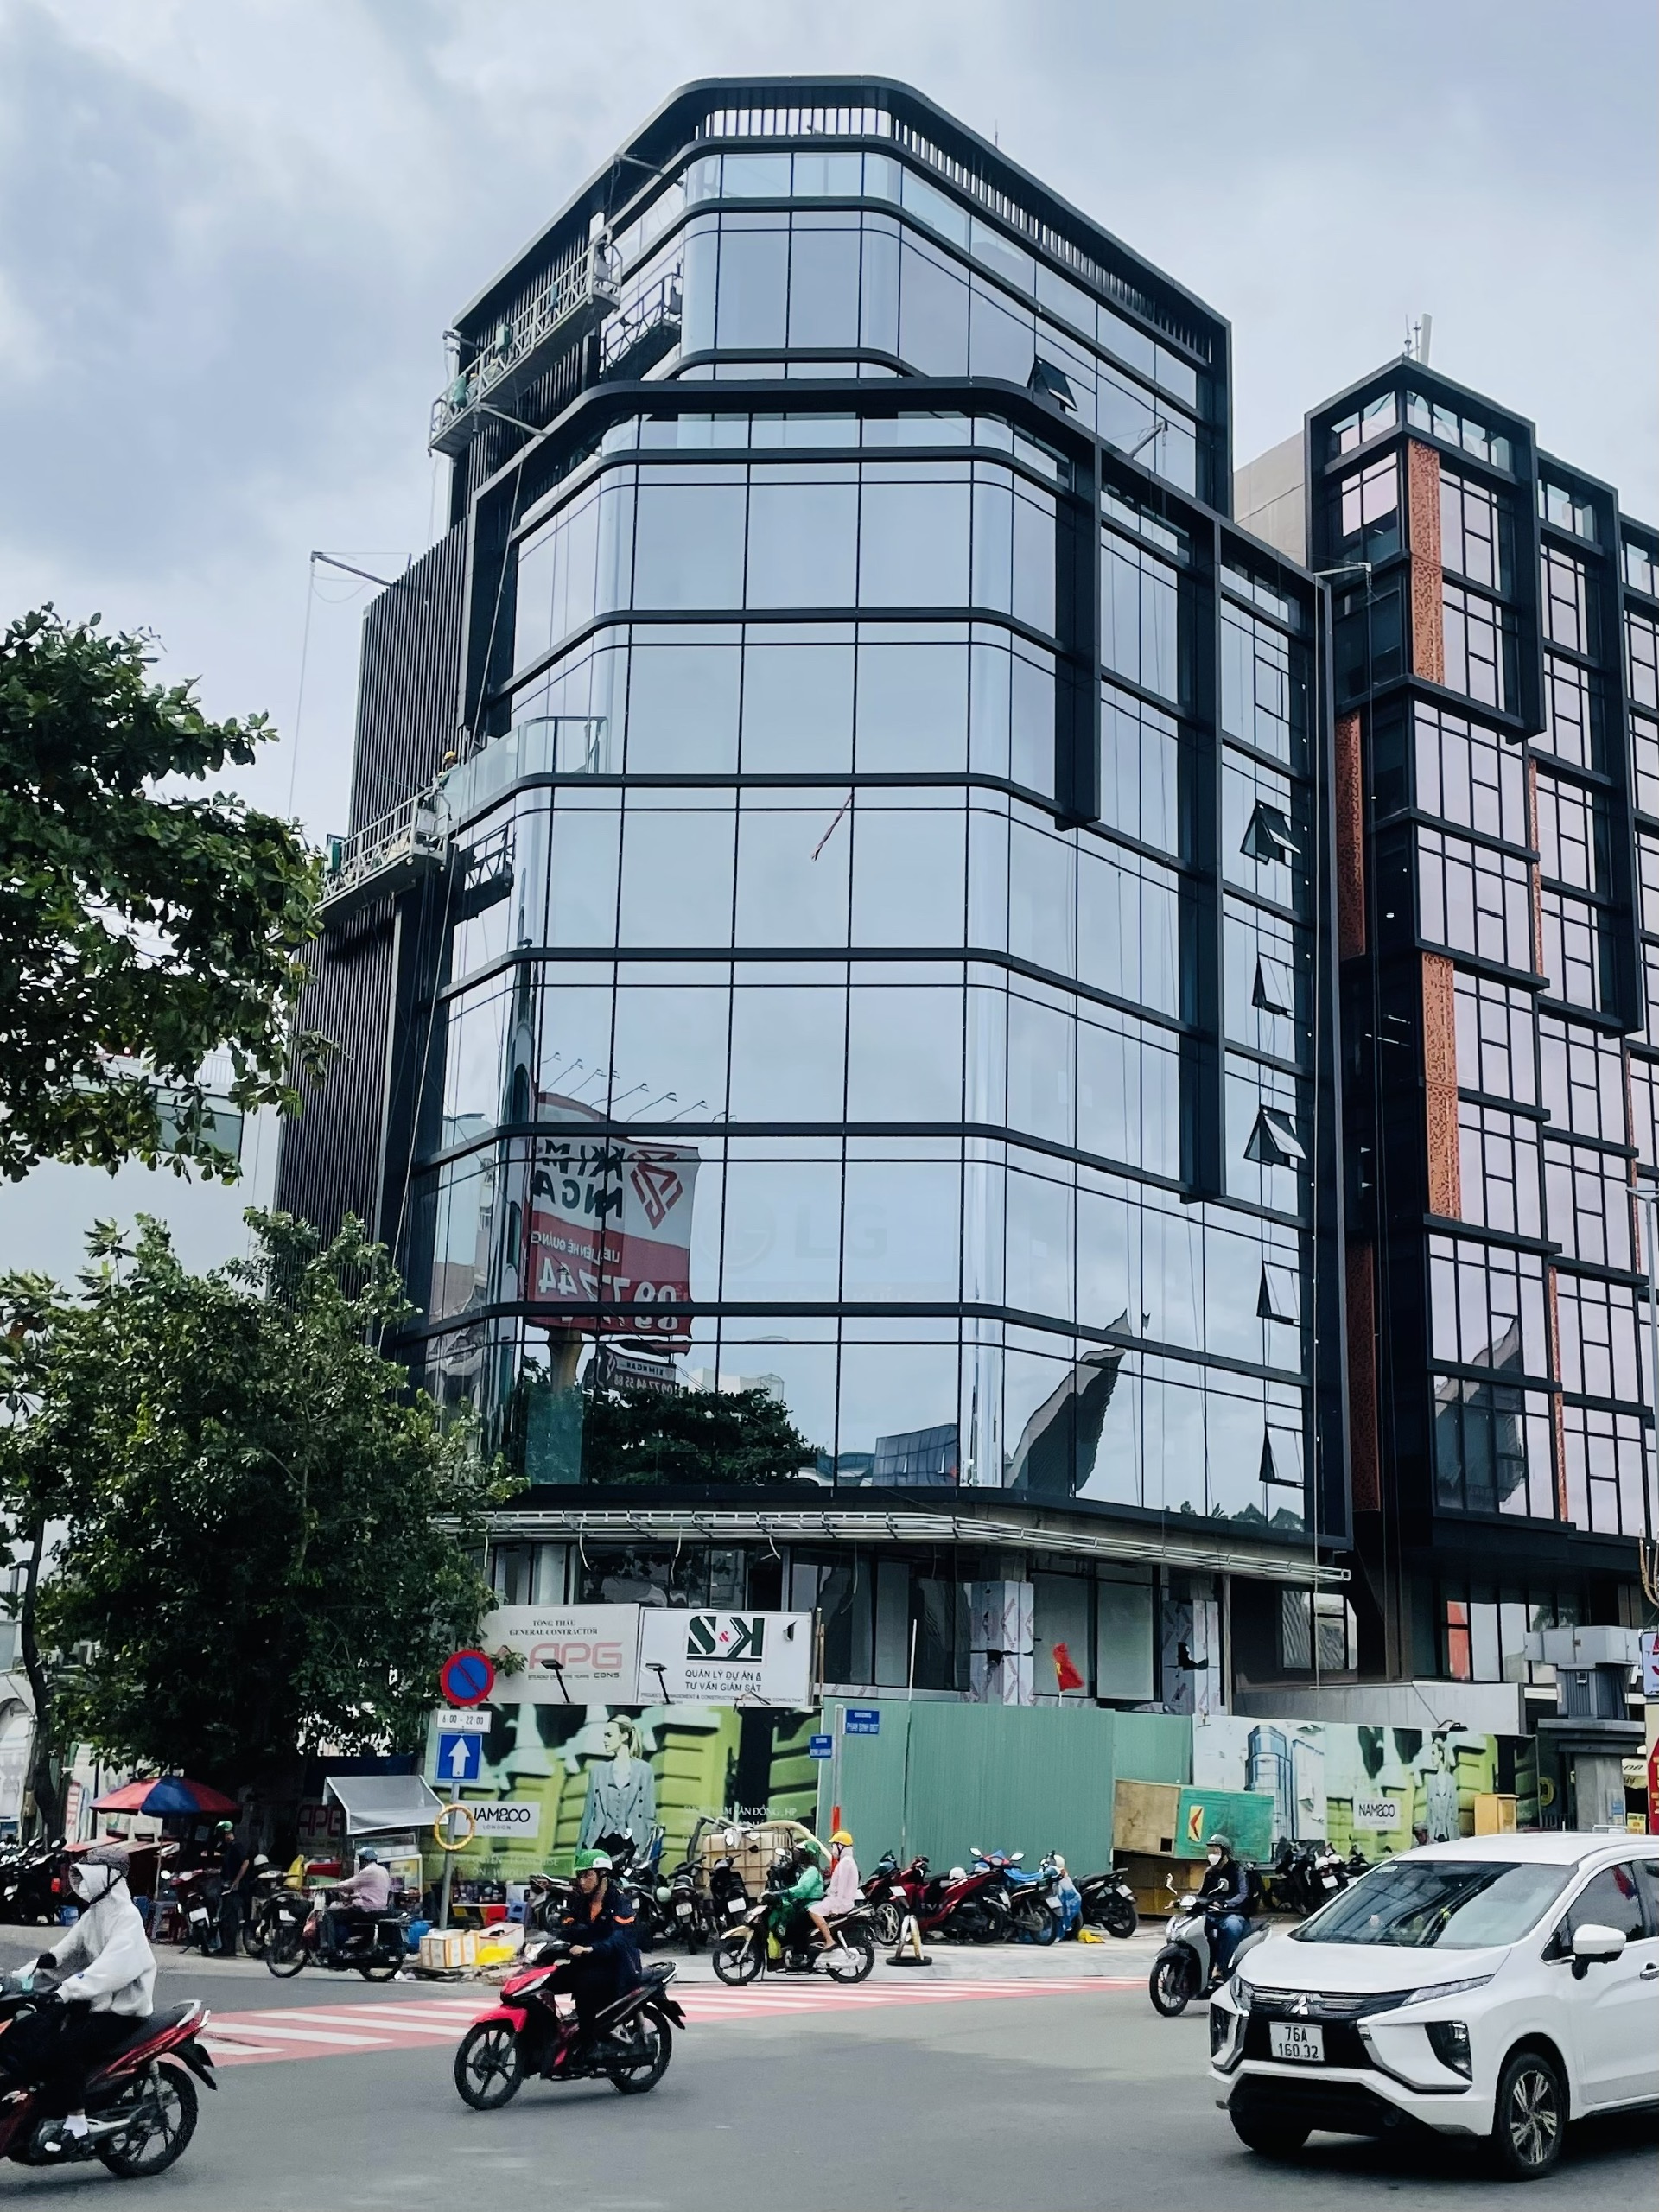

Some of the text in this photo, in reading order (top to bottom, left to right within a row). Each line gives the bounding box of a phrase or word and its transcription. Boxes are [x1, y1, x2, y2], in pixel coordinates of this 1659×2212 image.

[529, 1642, 623, 1670] APG
[685, 1669, 711, 1678] QUẢN
[725, 1671, 740, 1681] DỰ
[755, 1672, 762, 1681] &
[685, 1681, 697, 1690] TƯ
[700, 1681, 718, 1691] VẤN
[1285, 2026, 1307, 2042] 76A
